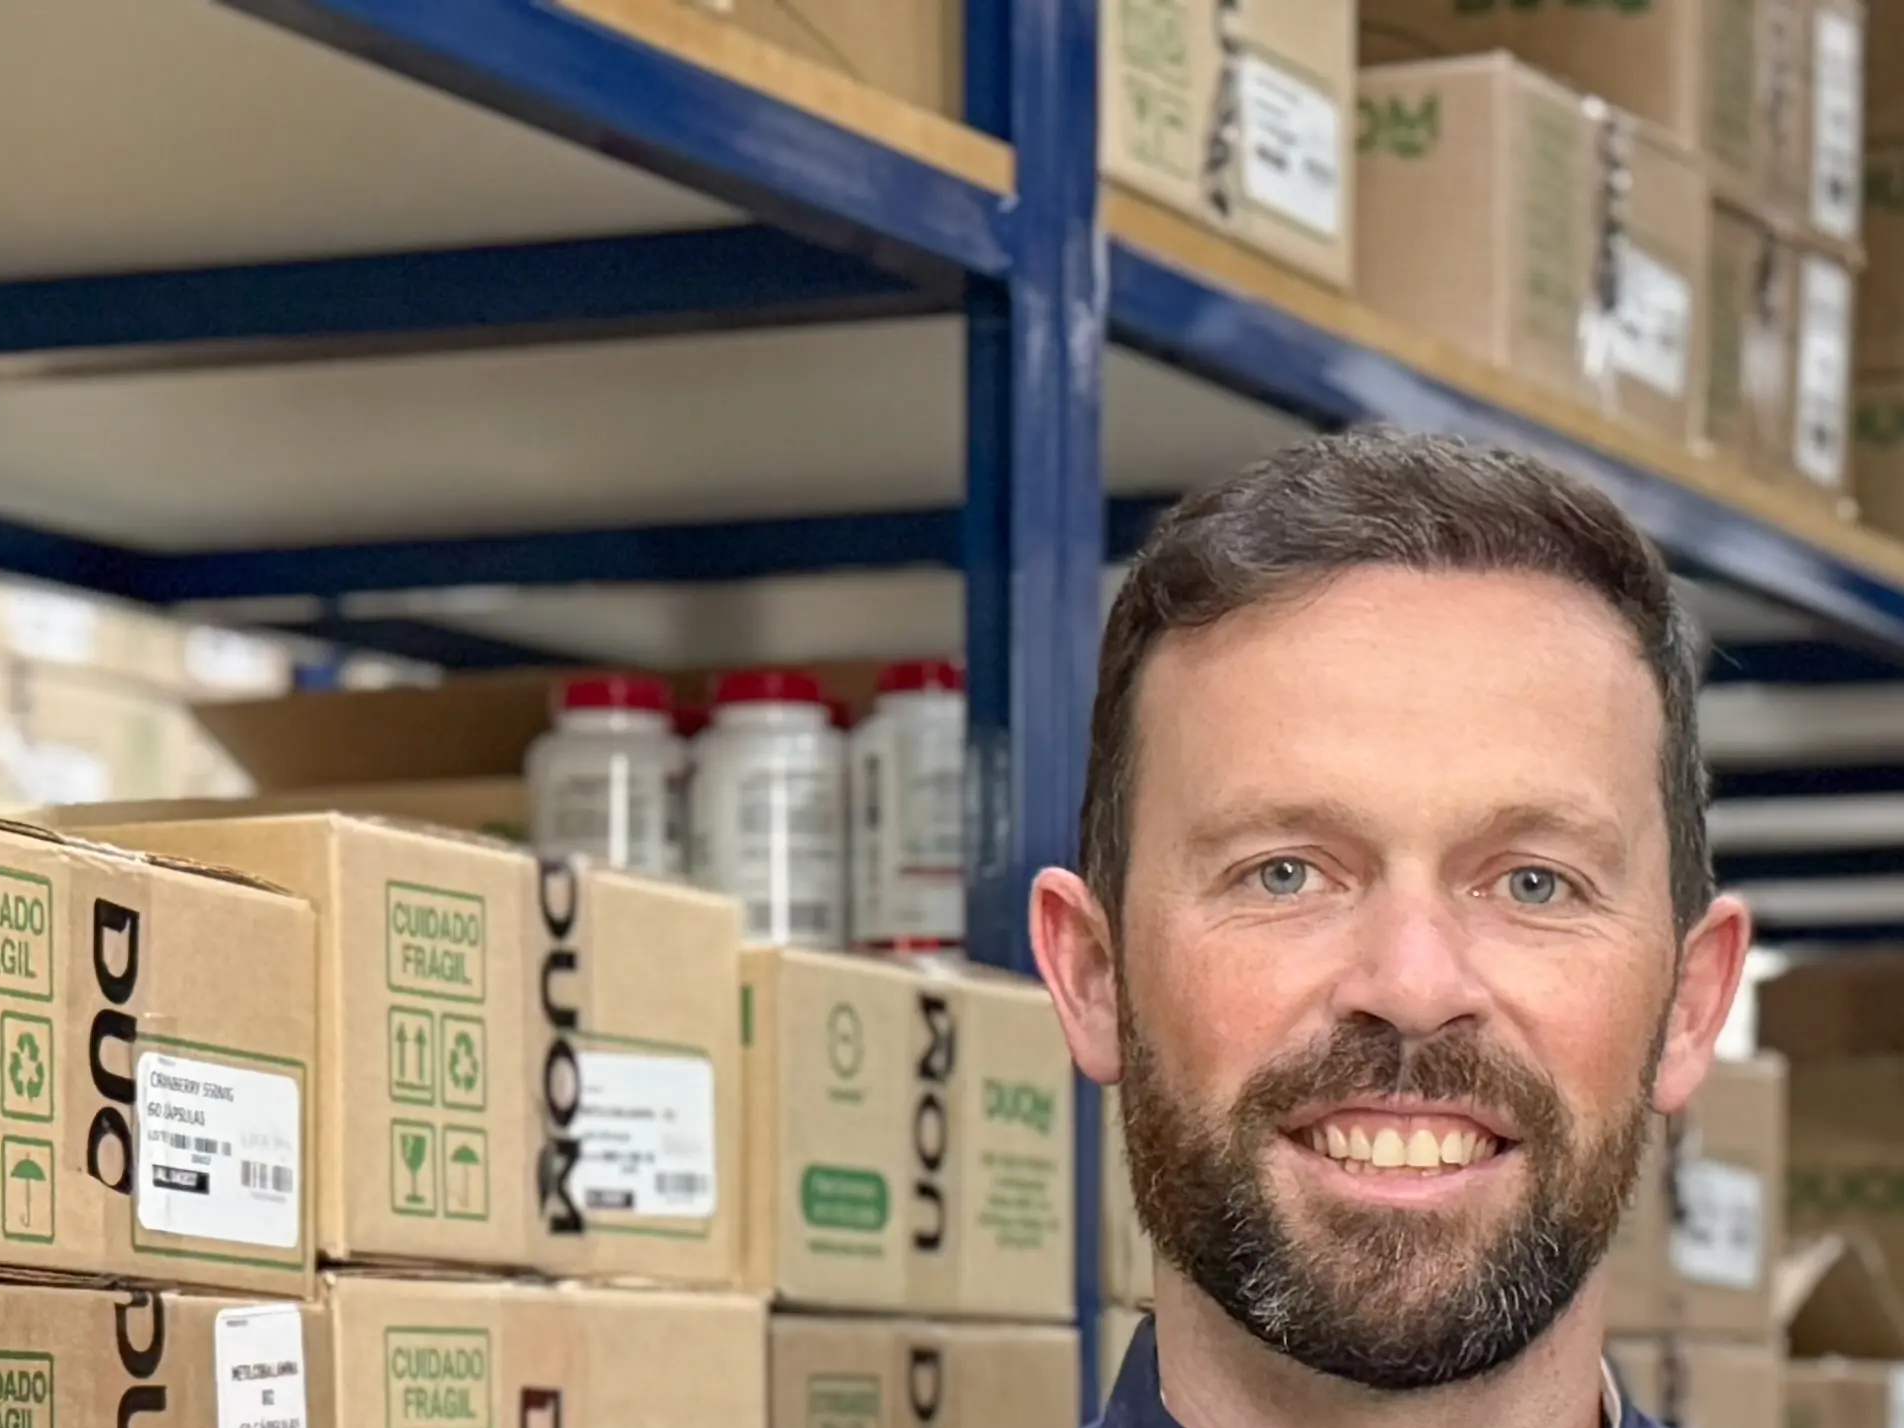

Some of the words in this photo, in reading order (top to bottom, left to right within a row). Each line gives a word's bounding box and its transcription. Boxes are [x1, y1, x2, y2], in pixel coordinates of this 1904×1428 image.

[392, 901, 480, 945] CUIDADO
[400, 943, 473, 985] FRÁGIL
[391, 1347, 486, 1382] CUIDADO
[402, 1386, 477, 1421] FRÁGIL
